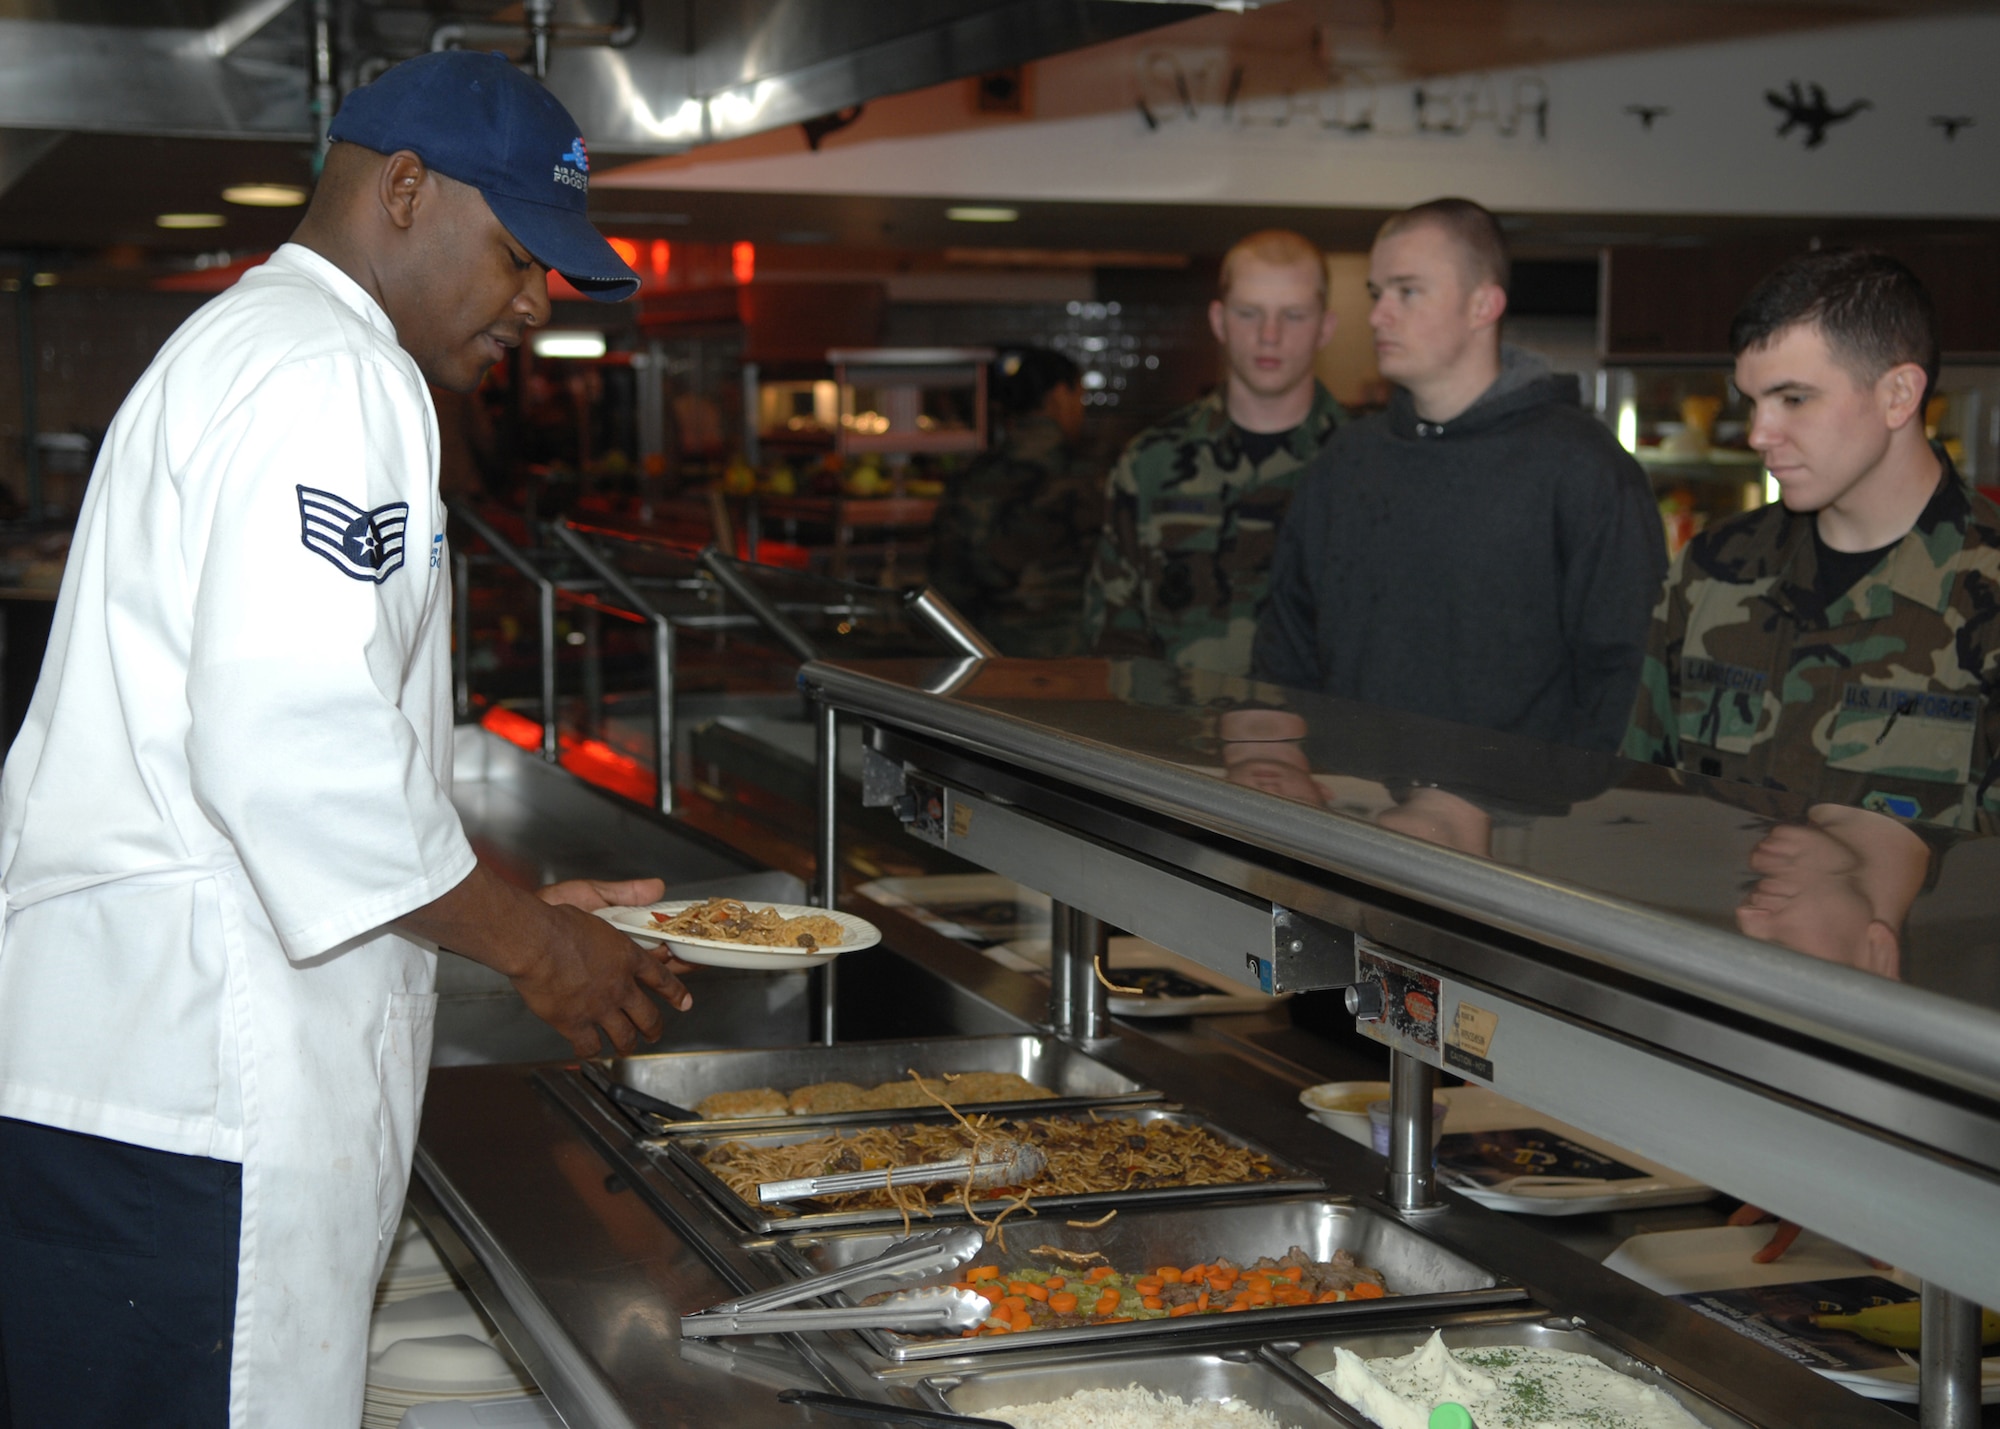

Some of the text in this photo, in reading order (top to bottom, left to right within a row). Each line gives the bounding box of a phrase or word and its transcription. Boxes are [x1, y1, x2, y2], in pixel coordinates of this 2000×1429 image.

[553, 164, 569, 175] AIR
[553, 172, 583, 190] FOOD
[1845, 685, 1975, 720] U.S. AIR FORCE
